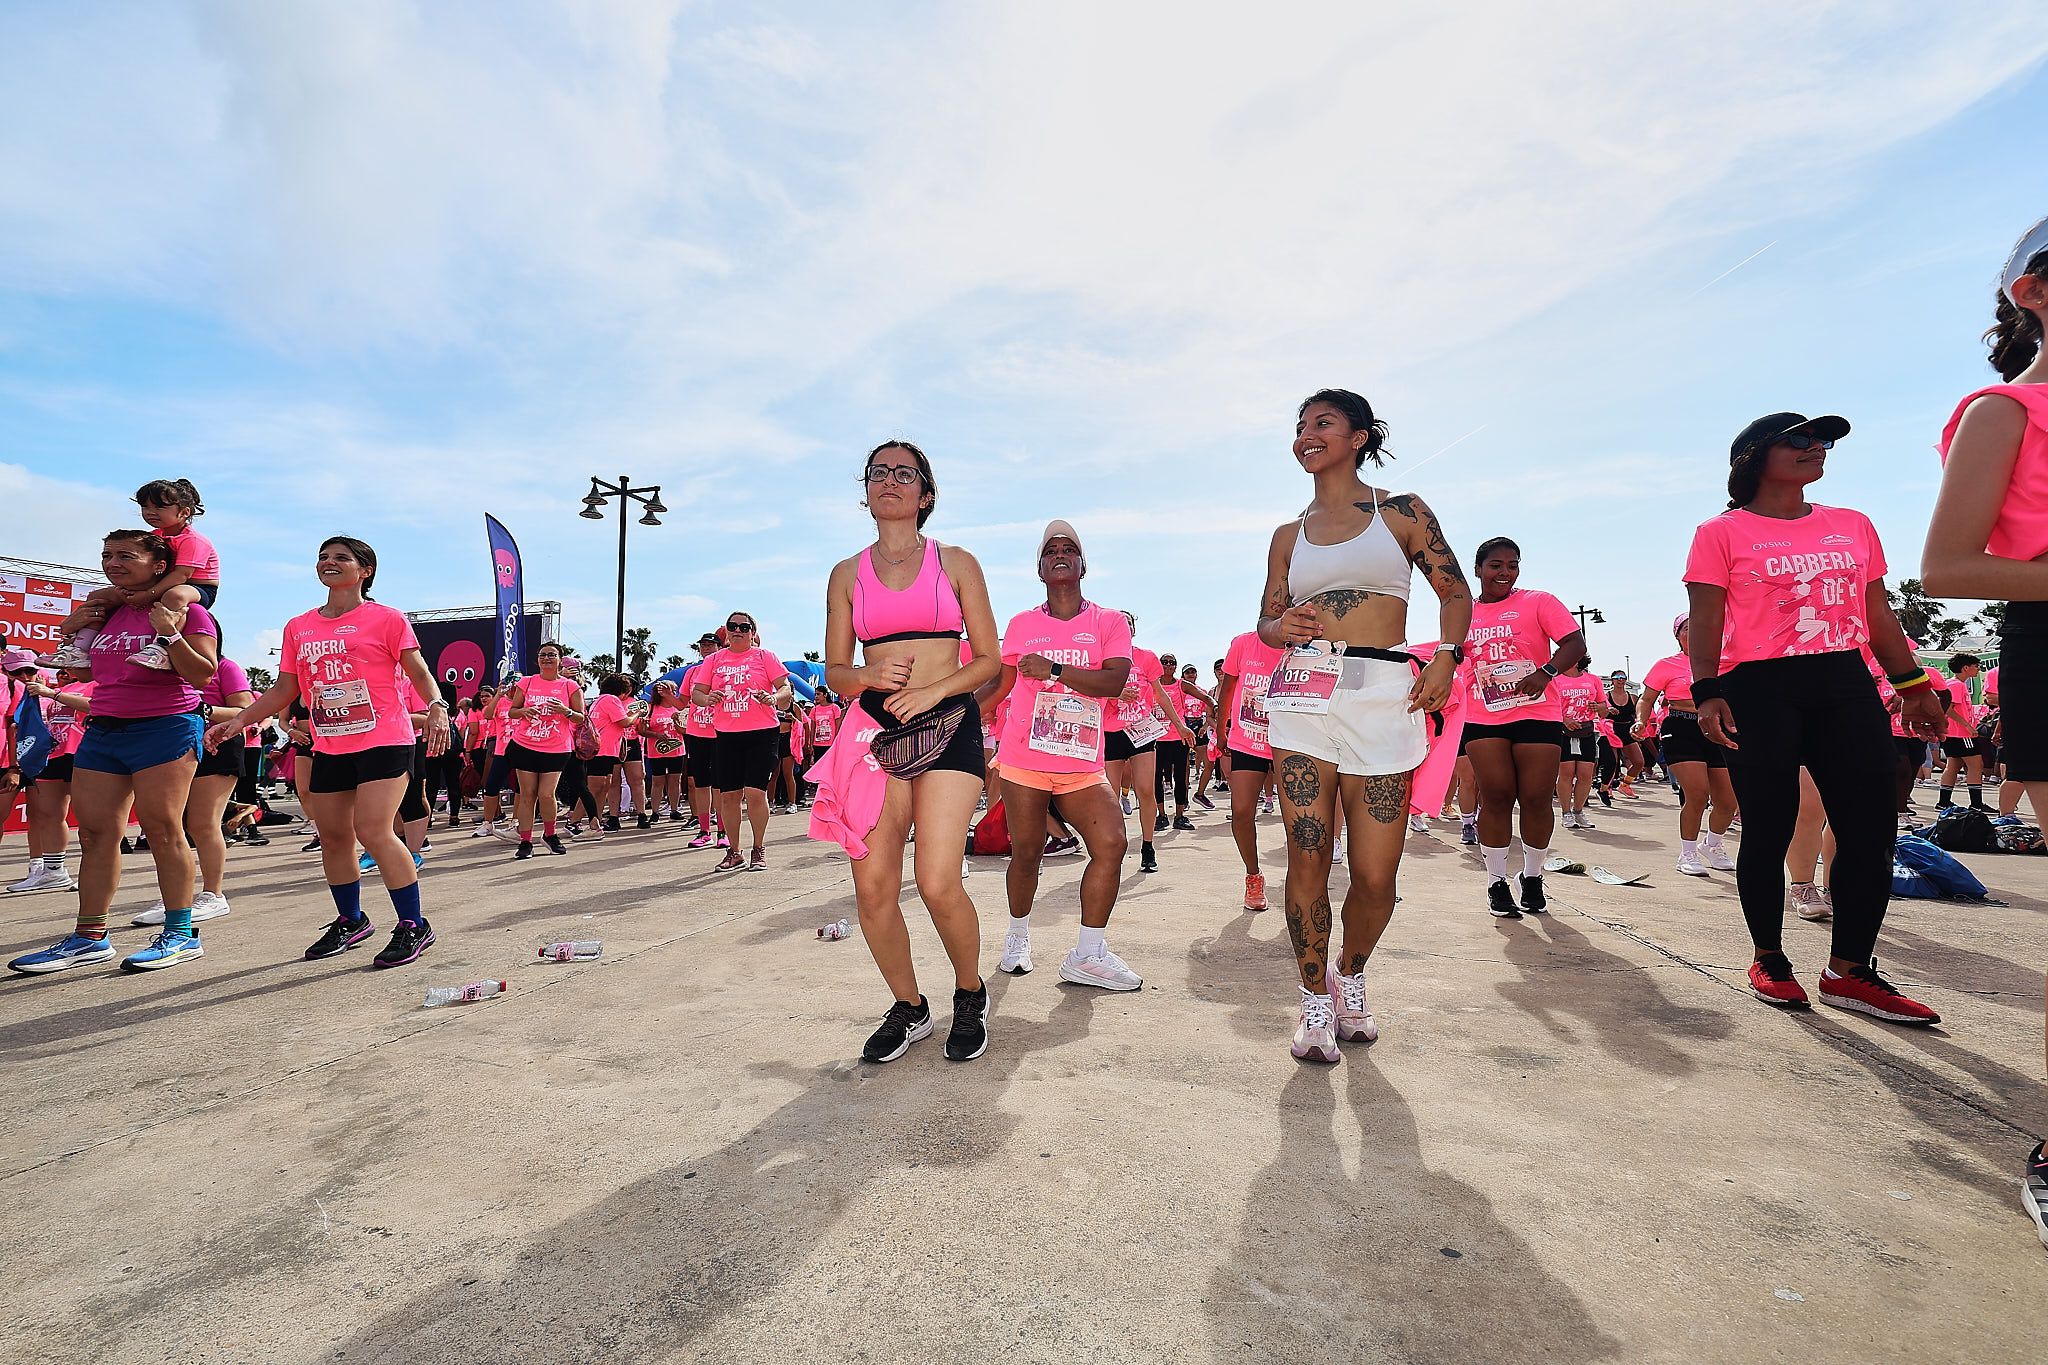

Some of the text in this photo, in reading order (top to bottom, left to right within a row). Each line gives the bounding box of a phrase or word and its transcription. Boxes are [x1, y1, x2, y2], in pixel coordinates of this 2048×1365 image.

[1752, 541, 1792, 551] OYSHO
[1766, 551, 1857, 576] CARRERA
[33, 587, 65, 596] Santander
[1822, 577, 1846, 606] DE
[32, 604, 64, 612] Santander
[0, 620, 62, 641] ONSE
[1467, 624, 1514, 641] ARRERA
[1025, 637, 1051, 646] OYSHO
[1284, 669, 1311, 683] 016
[723, 701, 749, 712] MUJER
[325, 707, 350, 718] 016
[1254, 710, 1267, 719] 01
[1055, 721, 1080, 734] 016
